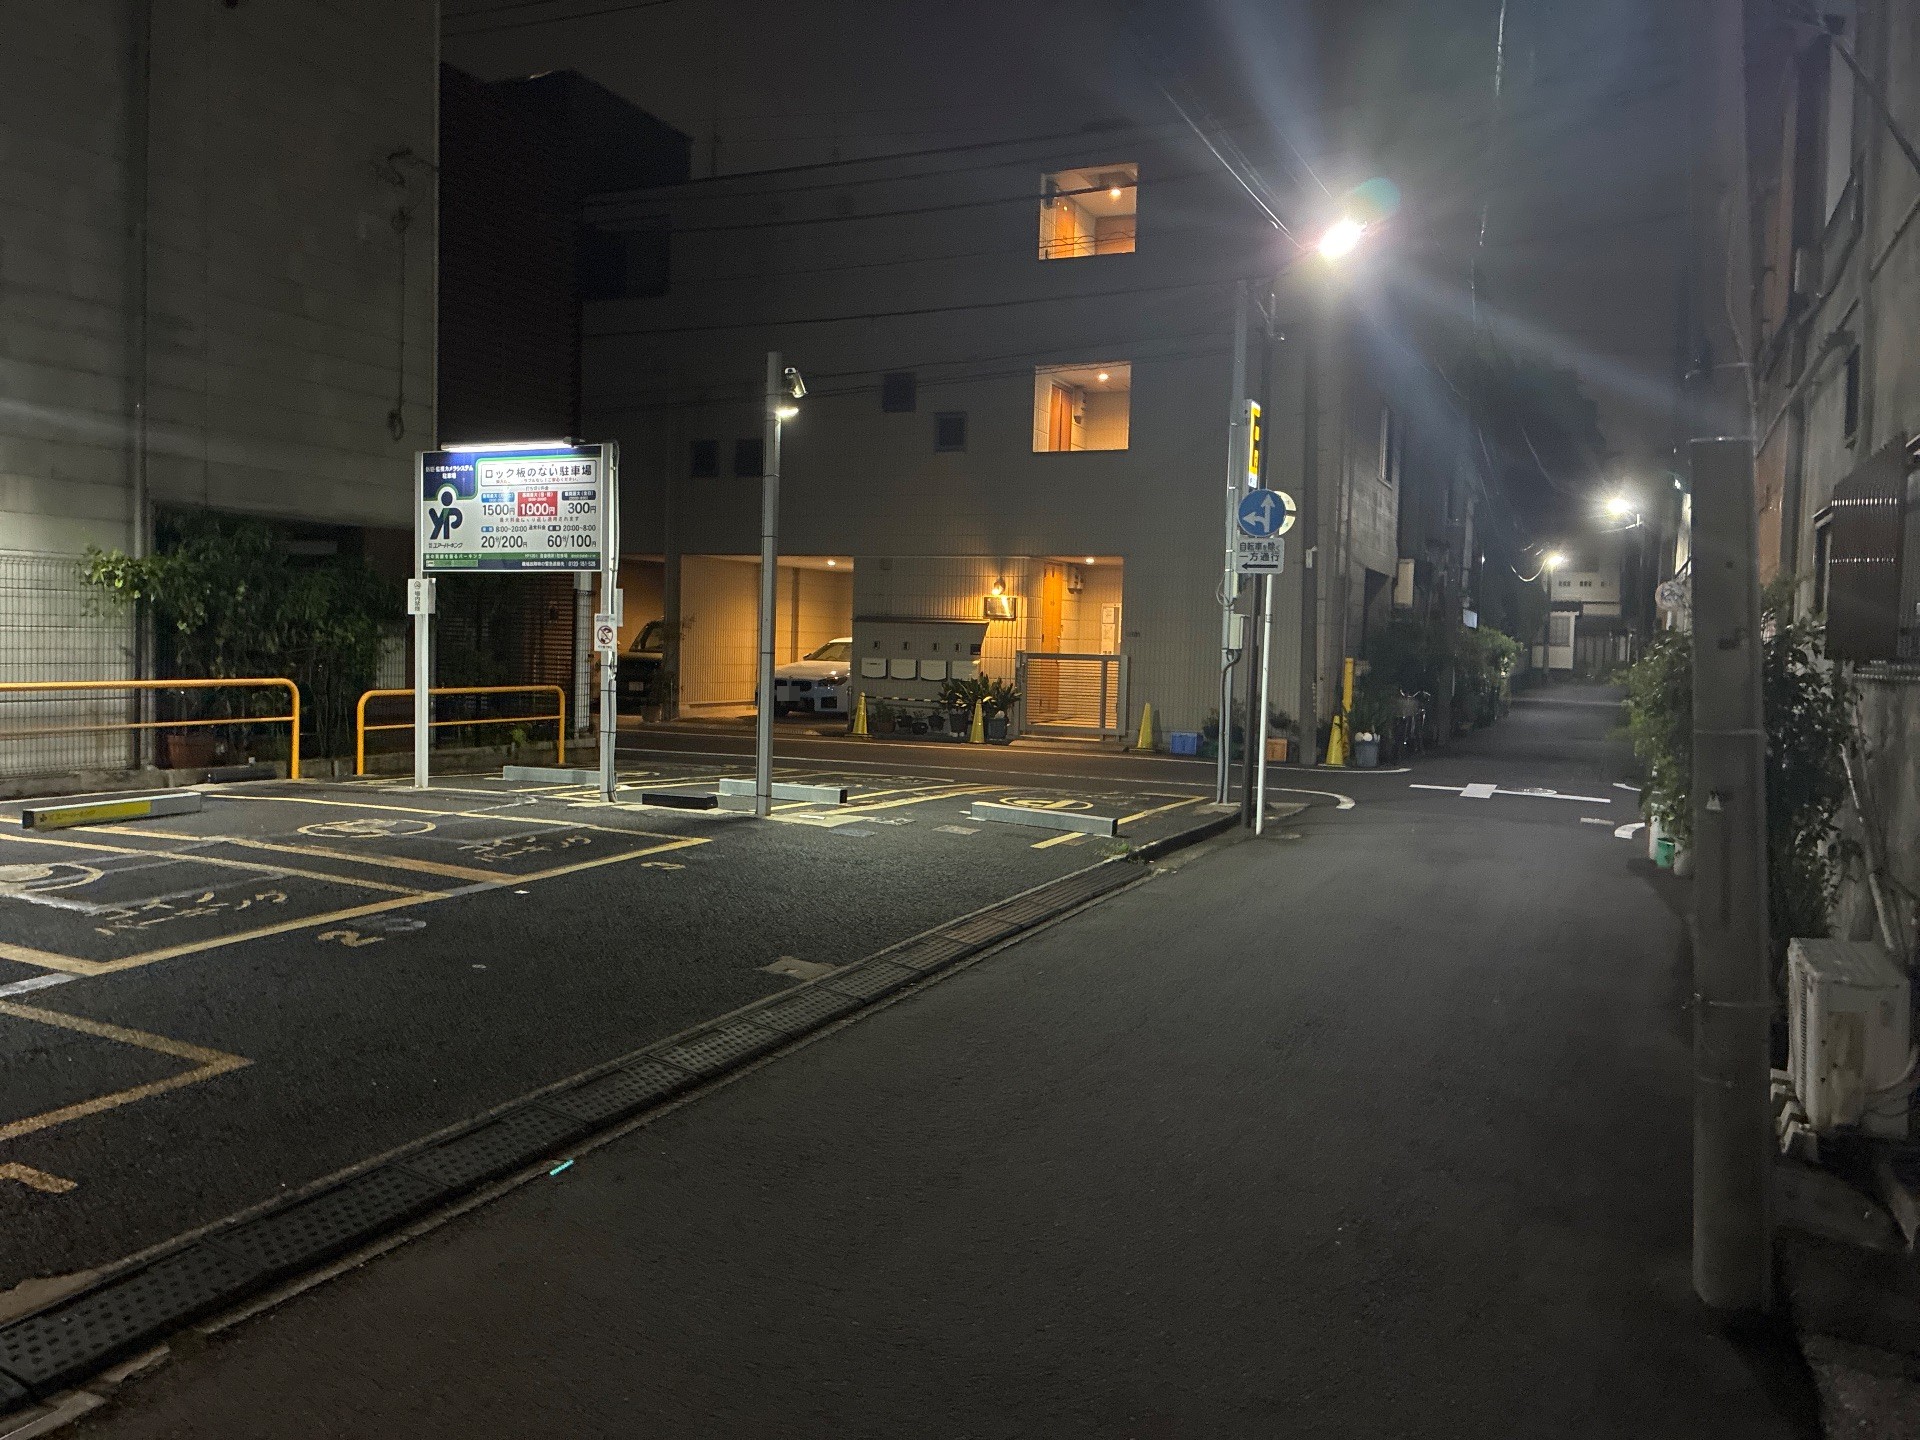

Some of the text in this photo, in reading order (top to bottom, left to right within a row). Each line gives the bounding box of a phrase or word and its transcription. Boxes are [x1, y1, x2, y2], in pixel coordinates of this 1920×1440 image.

[485, 464, 592, 479] ロック板のない駐車場
[482, 504, 515, 516] 1500円
[521, 503, 556, 515] 1000円
[568, 502, 597, 514] 300円
[1239, 542, 1280, 551] 自転車を除く
[1238, 552, 1280, 562] 一方通行
